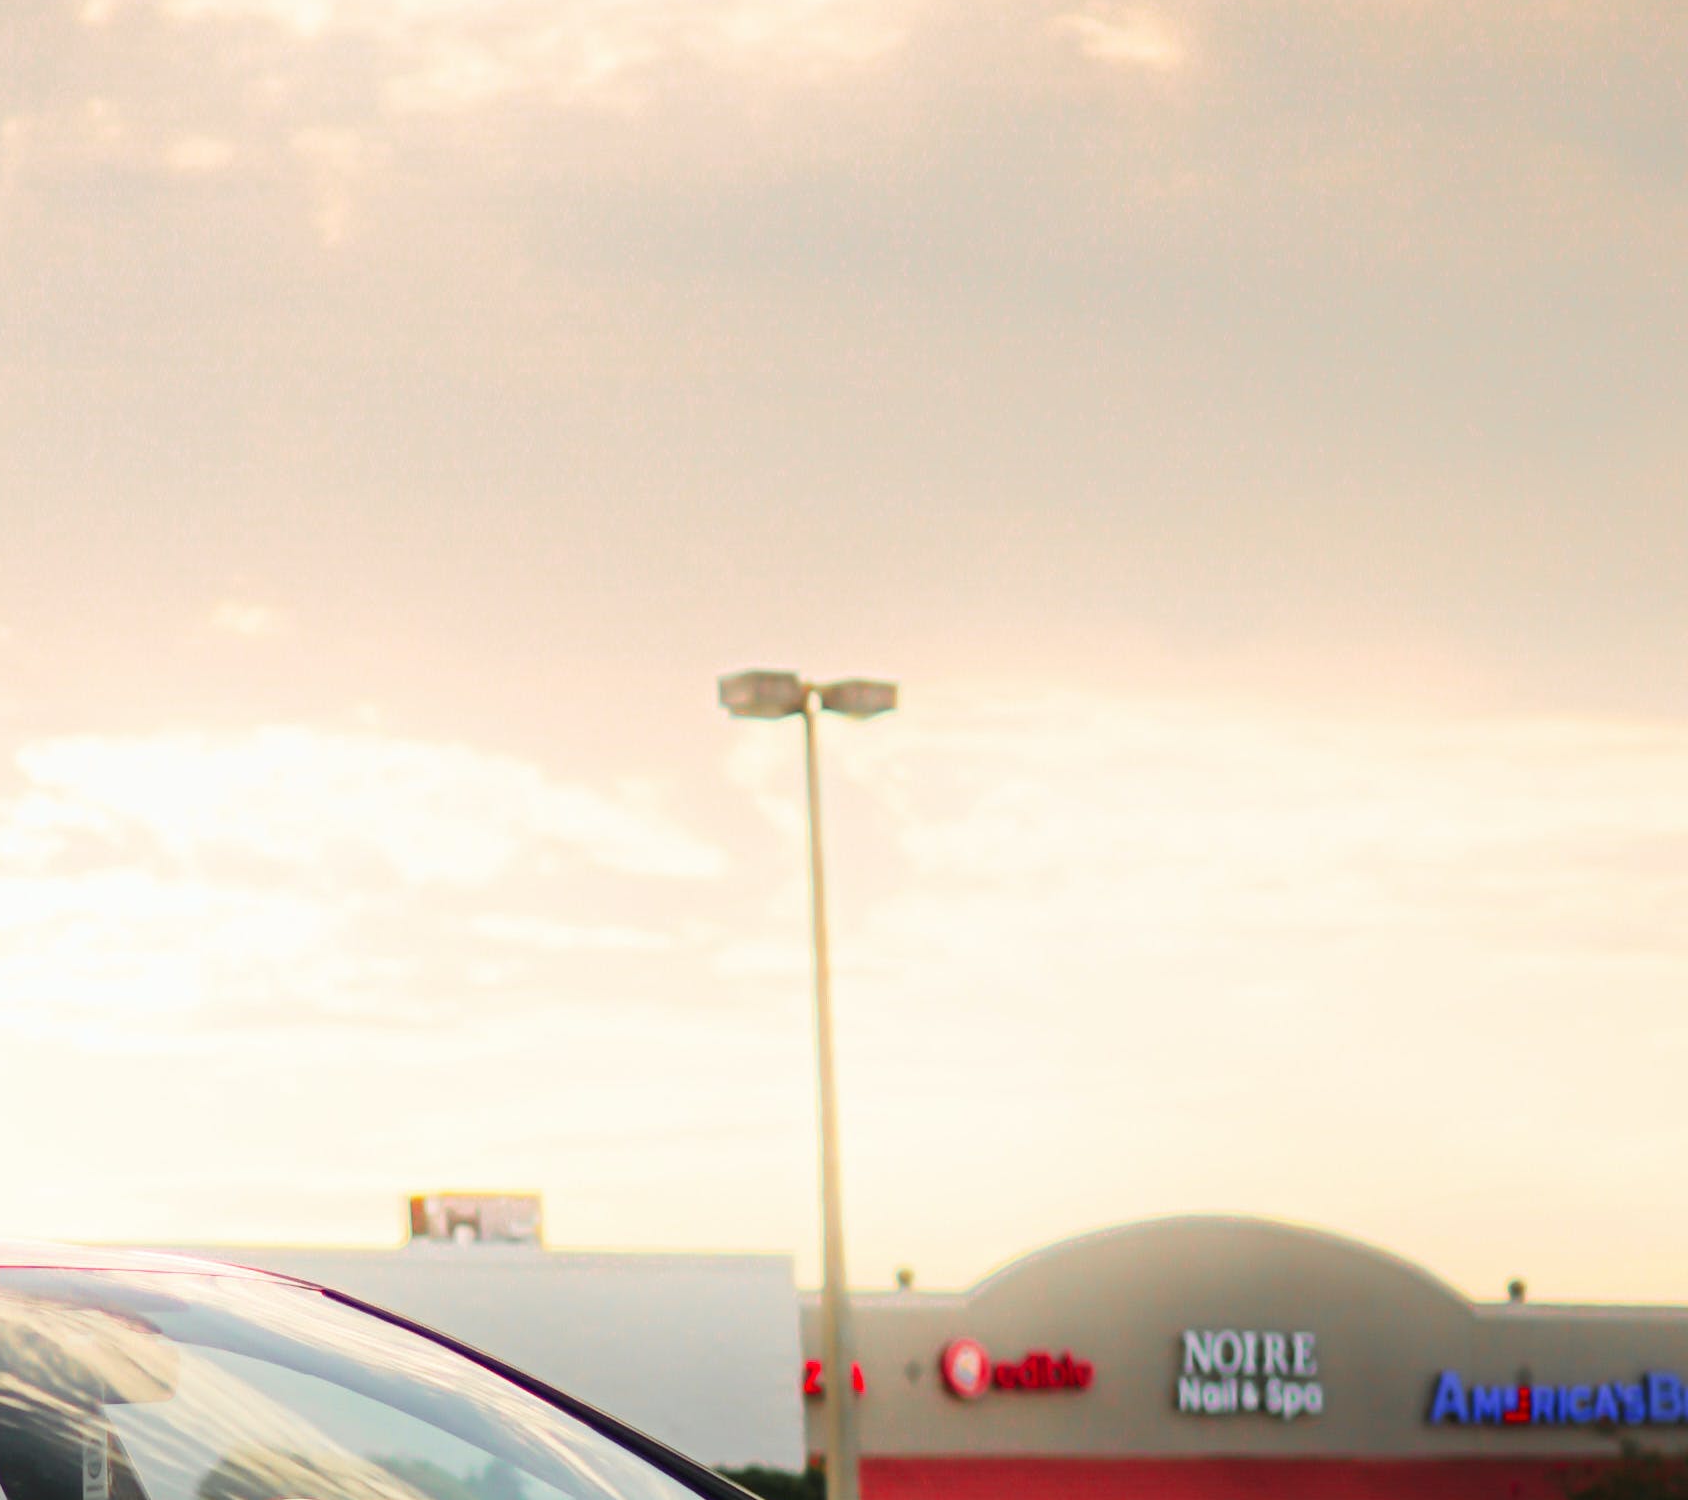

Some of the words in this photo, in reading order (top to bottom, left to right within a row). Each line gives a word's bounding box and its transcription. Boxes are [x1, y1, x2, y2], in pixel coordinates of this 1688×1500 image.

[993, 1350, 1094, 1389] edible
[1183, 1330, 1317, 1376] NOIRE
[1179, 1377, 1238, 1413] Nail
[1266, 1377, 1323, 1419] Spa
[1648, 1371, 1688, 1423] B
